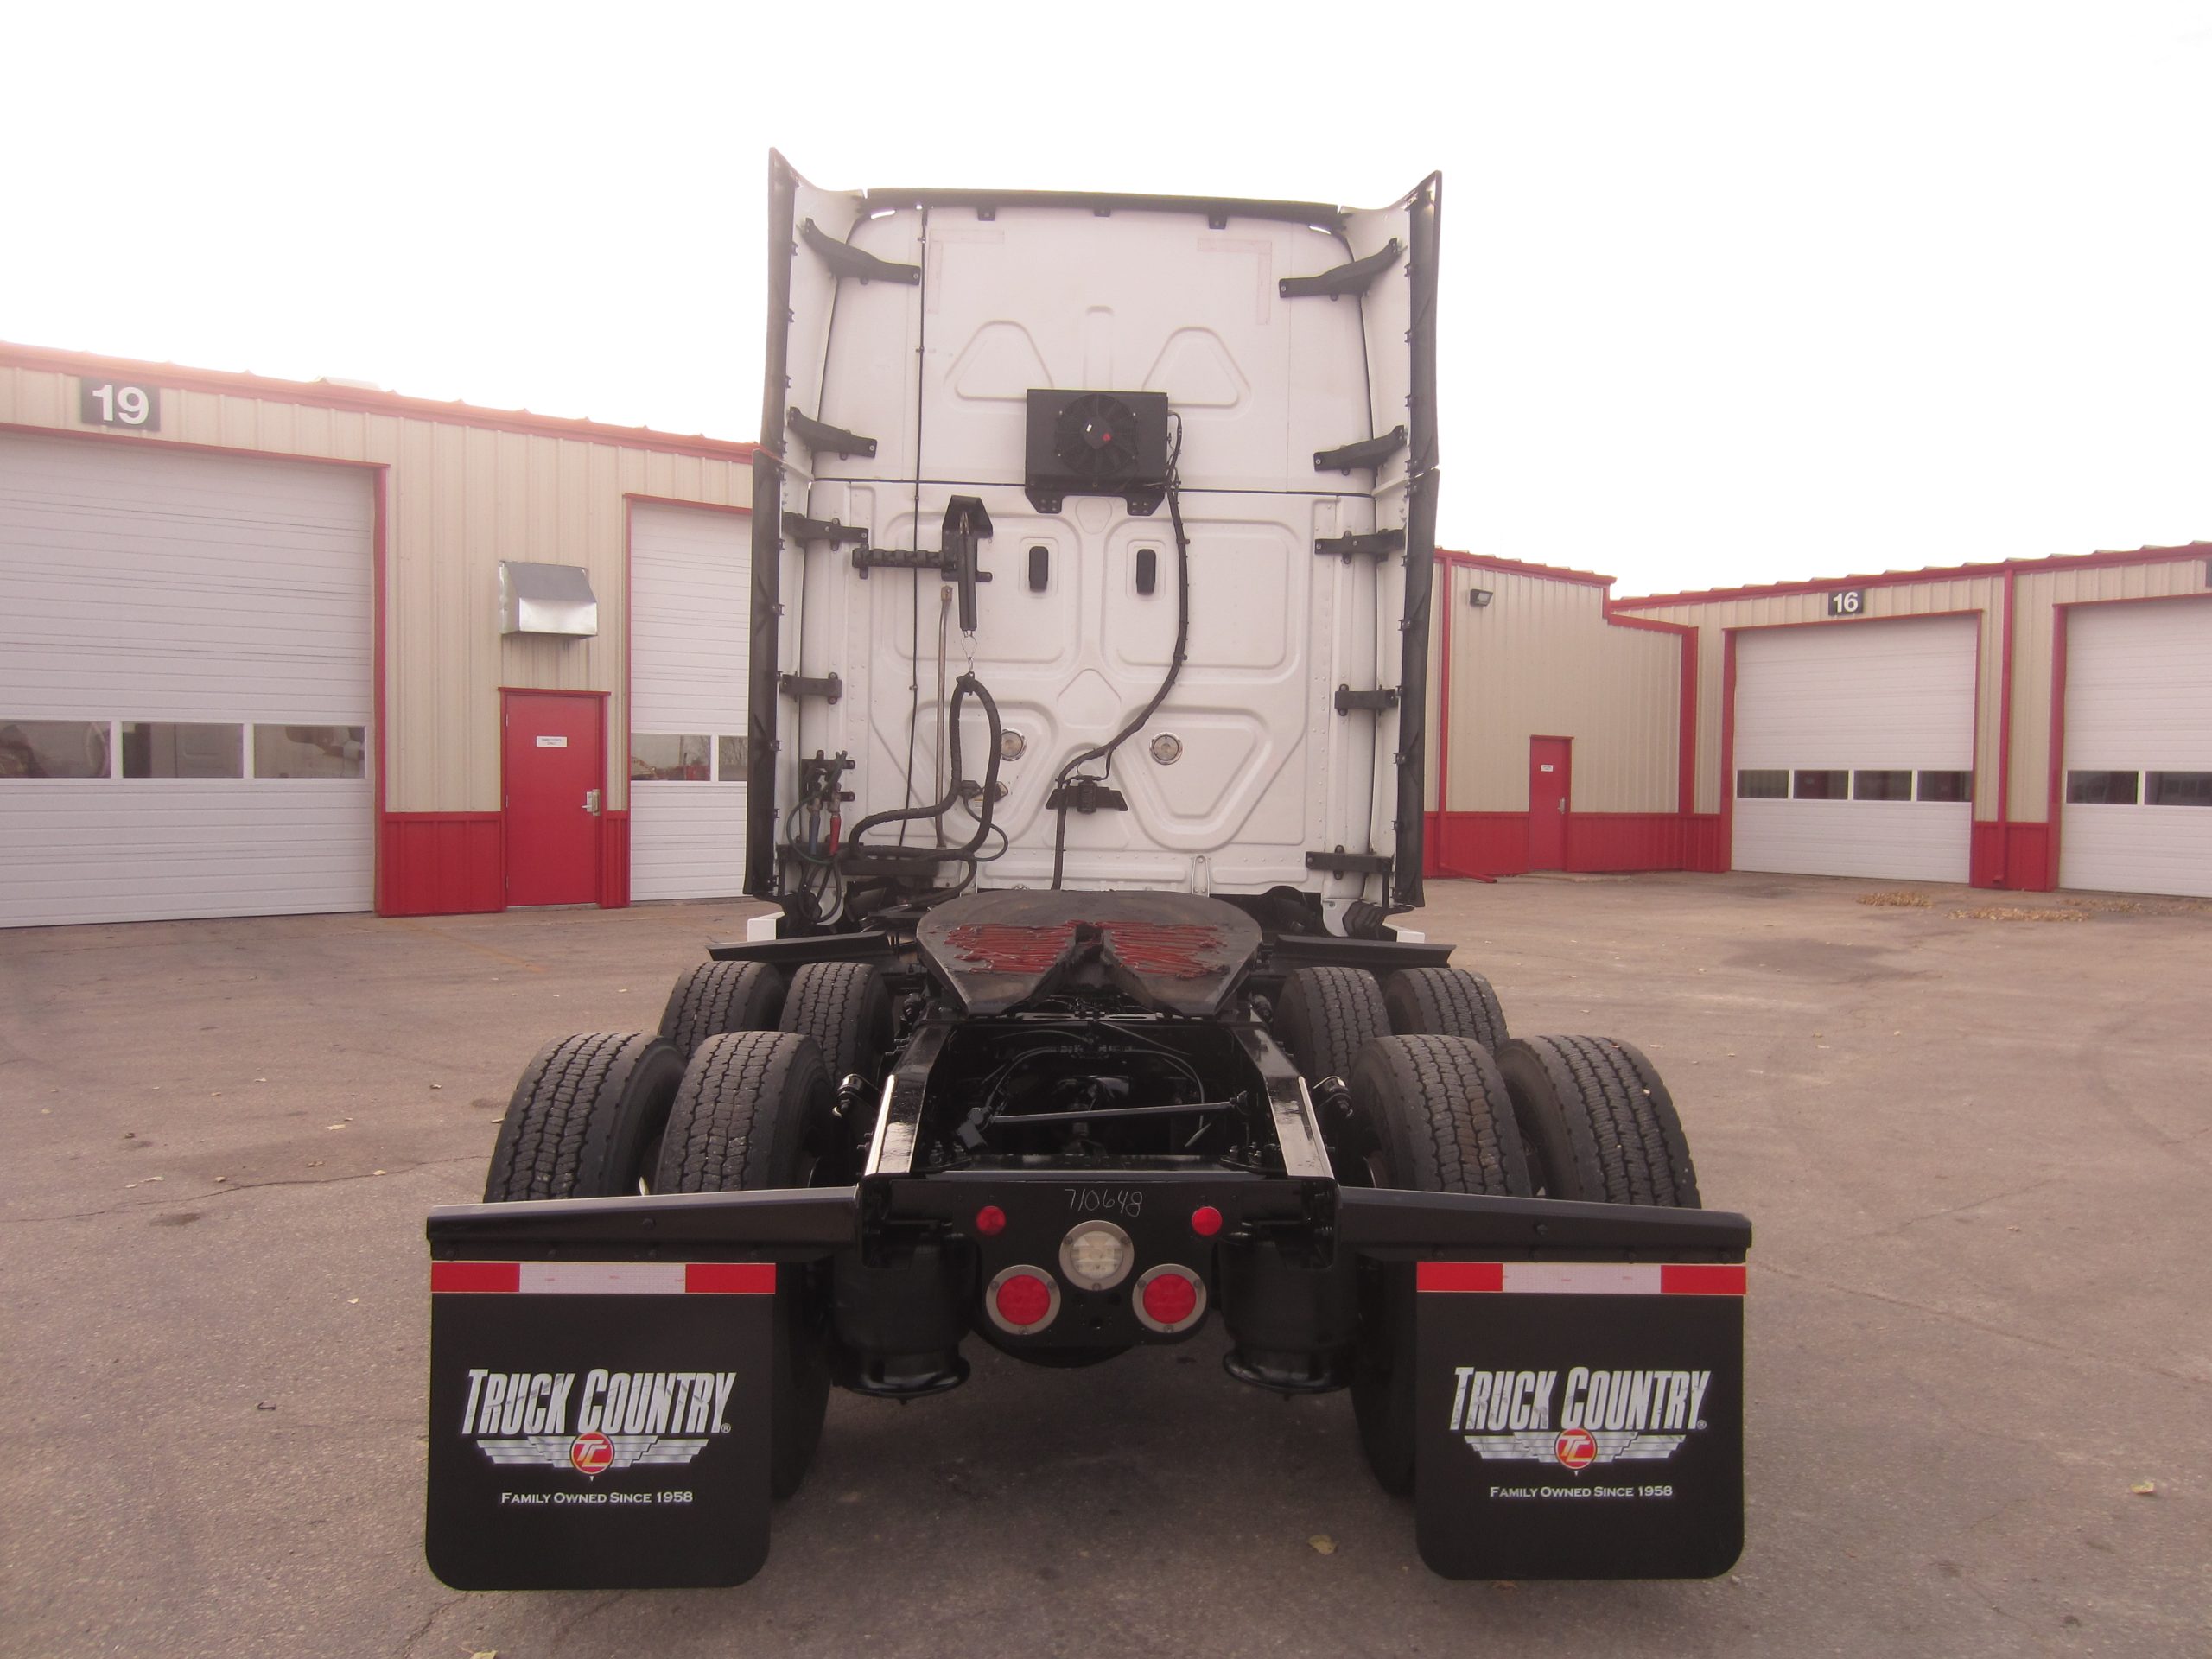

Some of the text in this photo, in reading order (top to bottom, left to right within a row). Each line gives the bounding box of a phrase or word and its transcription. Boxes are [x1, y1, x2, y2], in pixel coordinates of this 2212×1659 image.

[92, 384, 149, 424] 19
[1833, 591, 1859, 613] 16
[1064, 1188, 1143, 1217] 710648
[461, 1369, 575, 1435] TRUCK
[1449, 1366, 1558, 1431] TRUCK
[501, 1491, 694, 1504] FAMILY OWNED SINCE 1958
[1490, 1485, 1673, 1498] FAMILY OWNED SINCE 1958
